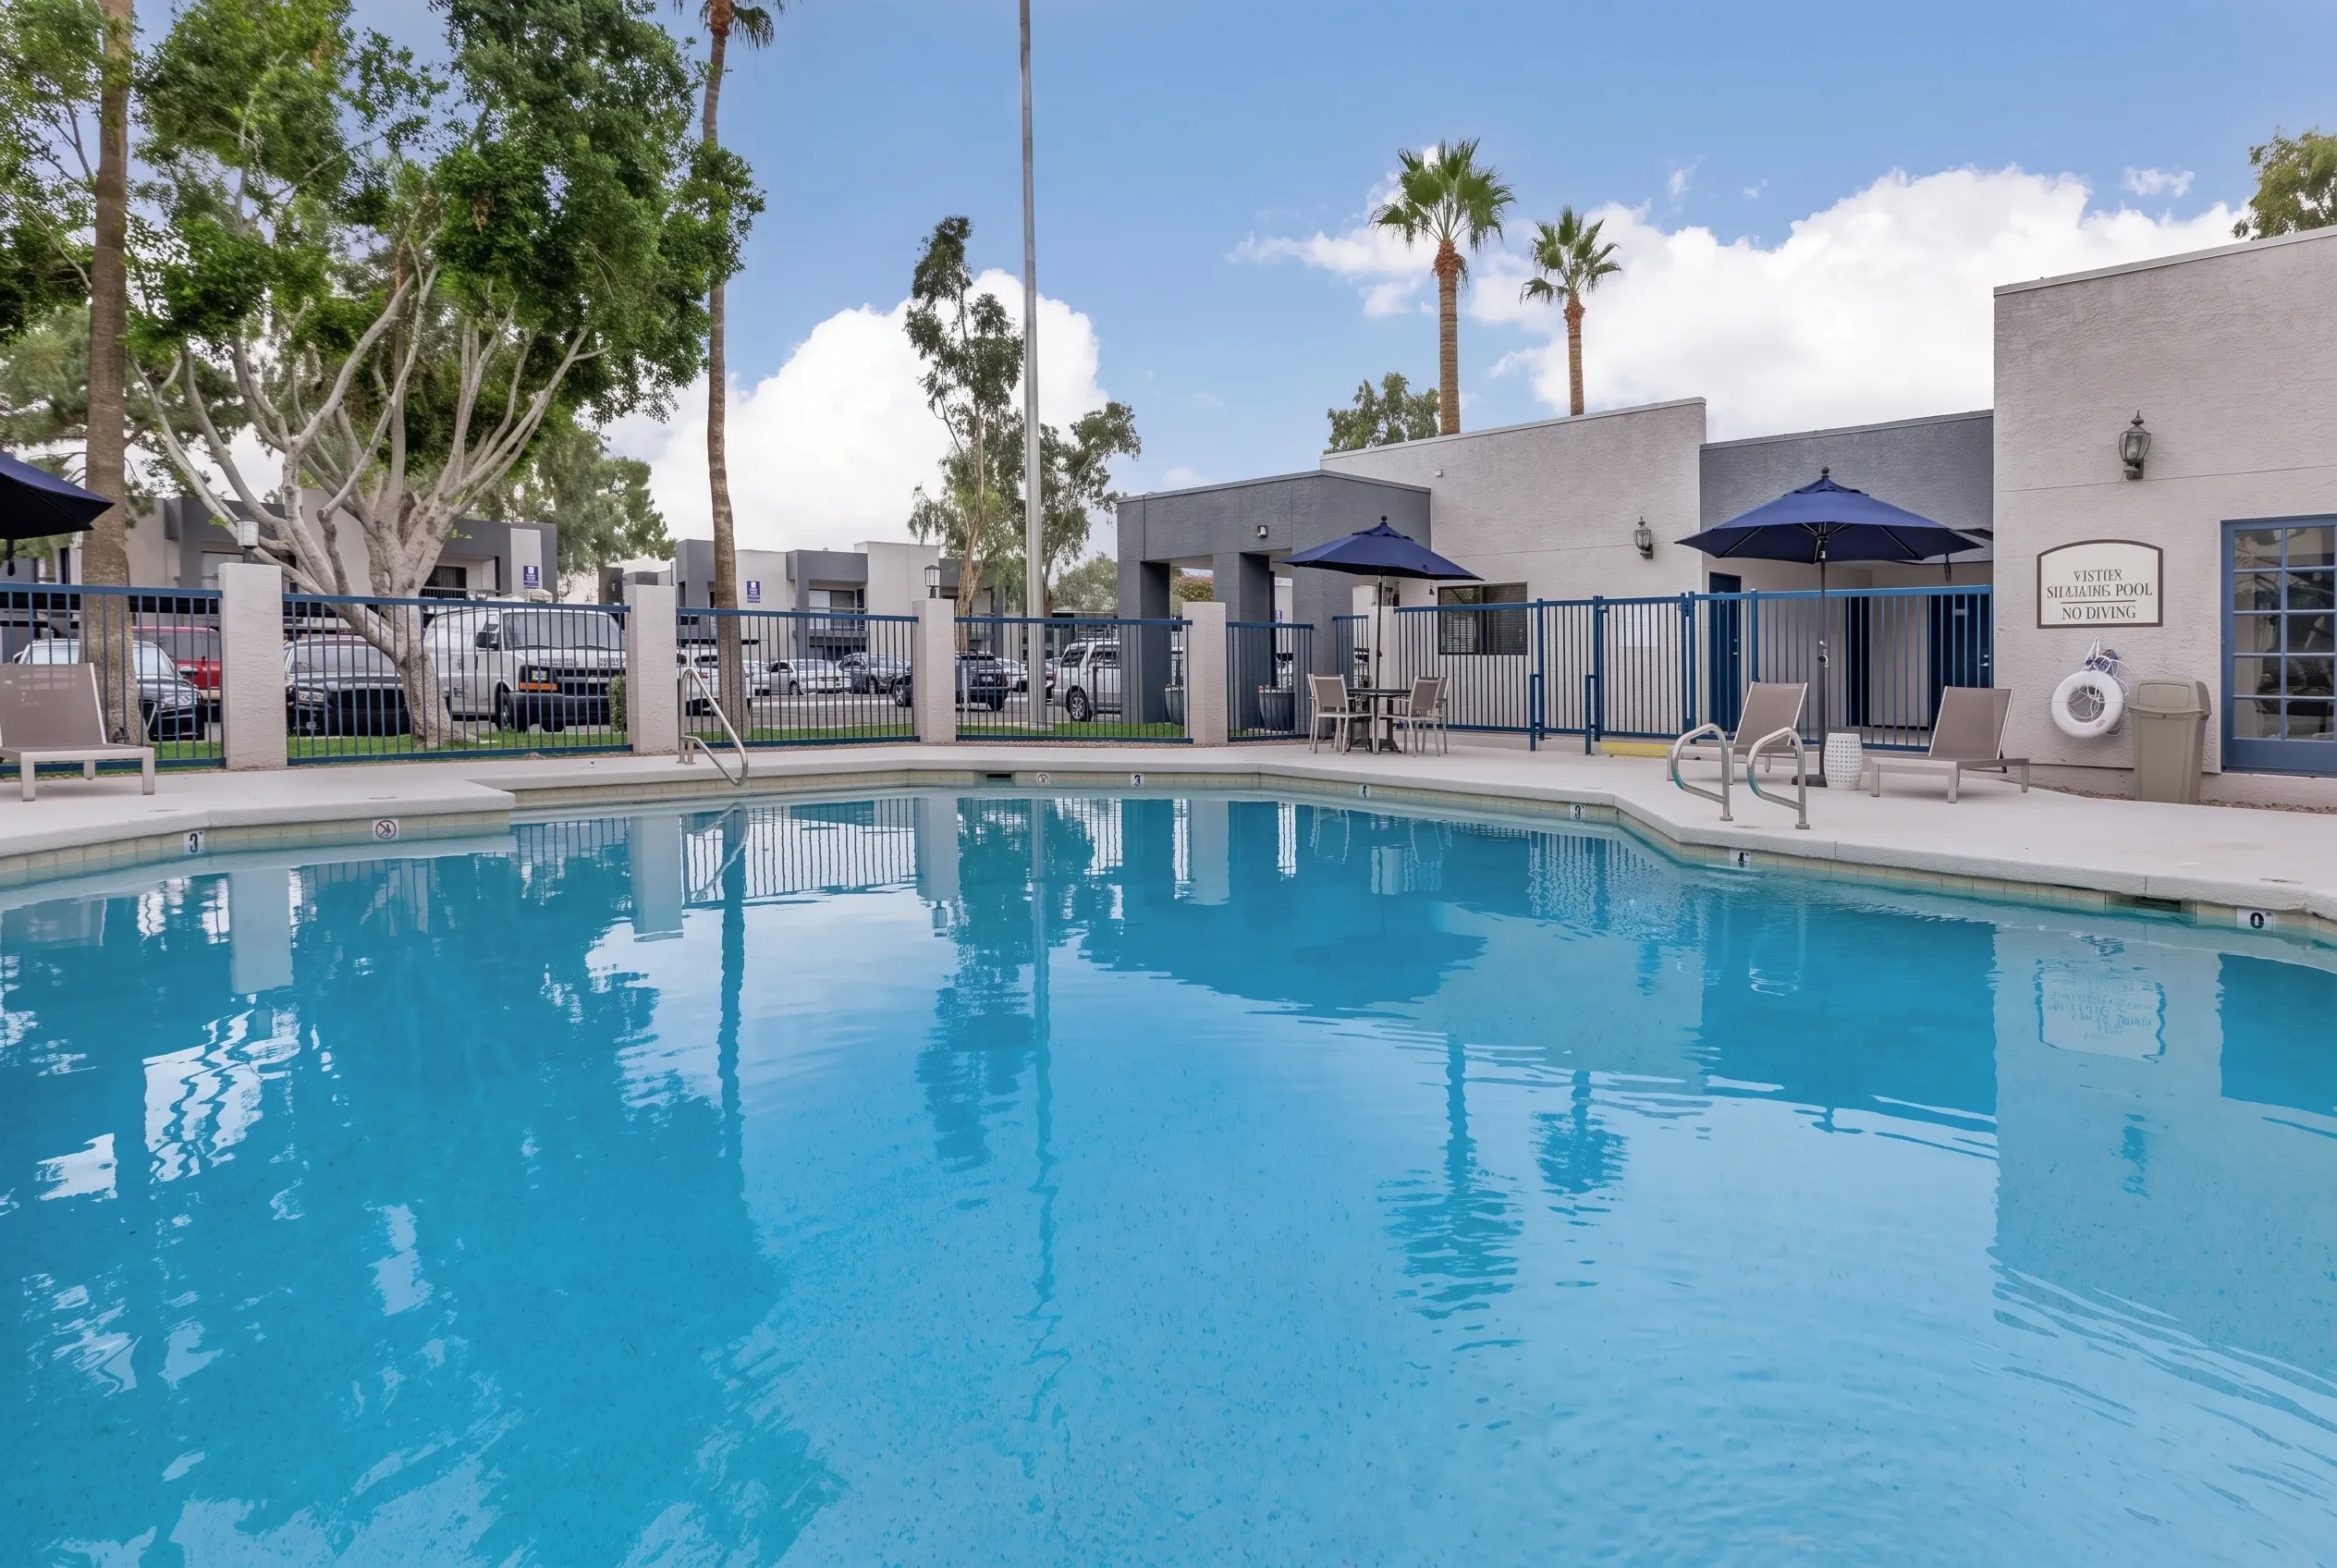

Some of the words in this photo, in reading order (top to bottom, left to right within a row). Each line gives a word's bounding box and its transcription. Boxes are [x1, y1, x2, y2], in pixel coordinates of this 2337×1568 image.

[2115, 582, 2153, 596] POOL
[2062, 606, 2082, 620] NO
[2086, 606, 2136, 619] DIVING
